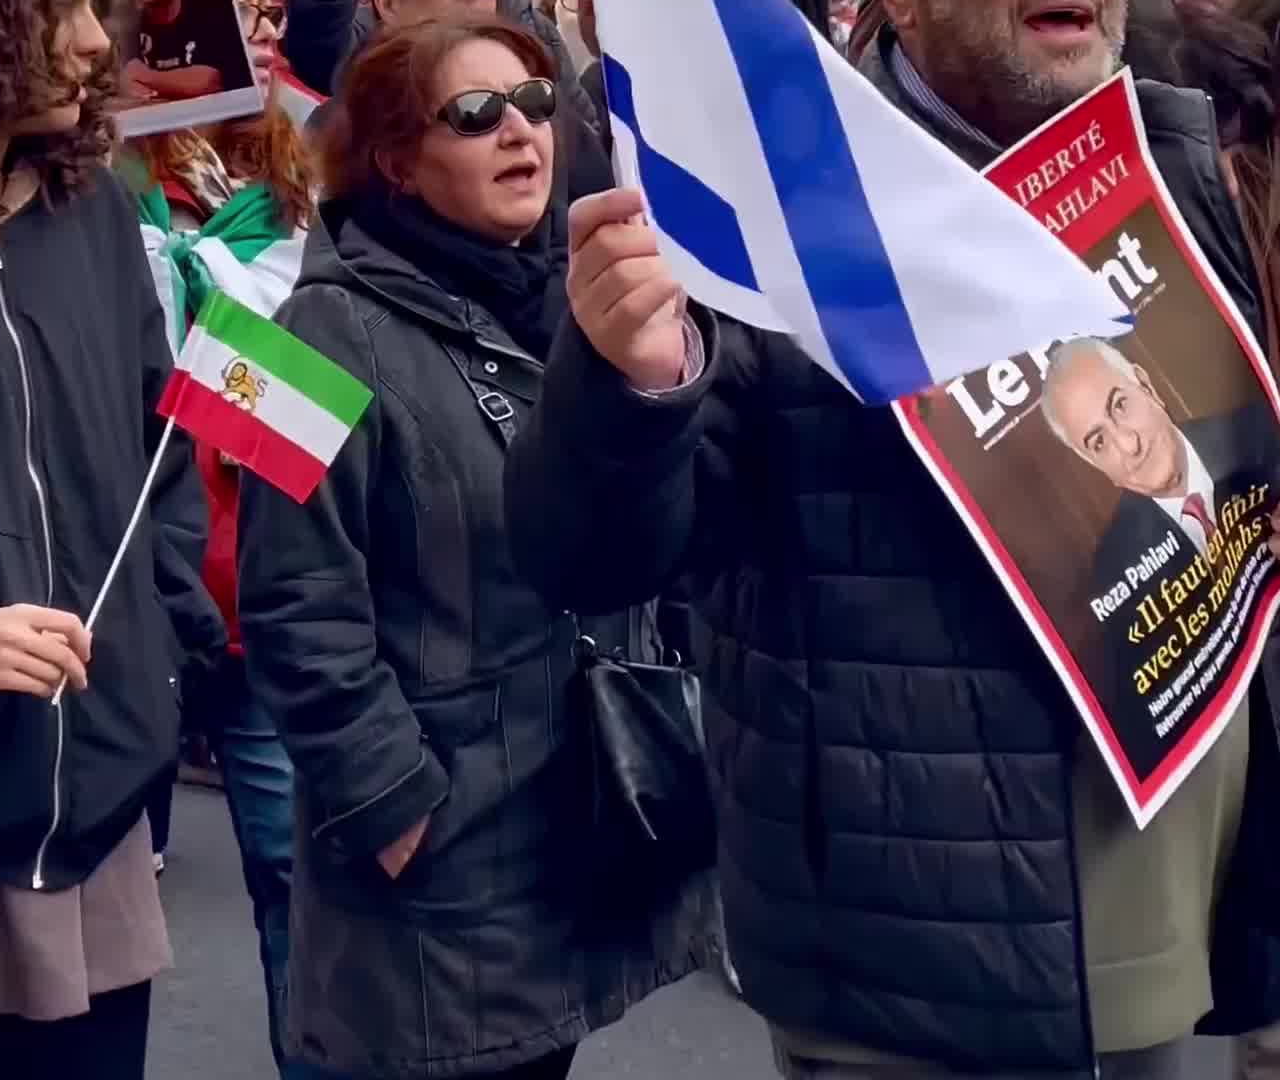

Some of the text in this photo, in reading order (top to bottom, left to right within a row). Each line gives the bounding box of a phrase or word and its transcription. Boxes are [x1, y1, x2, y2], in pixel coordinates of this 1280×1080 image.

[1014, 119, 1106, 207] IBERTÉ
[1043, 152, 1133, 234] AHLAVI
[944, 359, 1031, 439] Le
[1090, 529, 1181, 623] Reza Pahlavi
[1159, 553, 1208, 612] faut
[1207, 527, 1225, 565] en
[1221, 482, 1270, 536] finir
[1133, 633, 1184, 696] avec
[1176, 602, 1211, 647] les
[1207, 515, 1263, 613] mollahs
